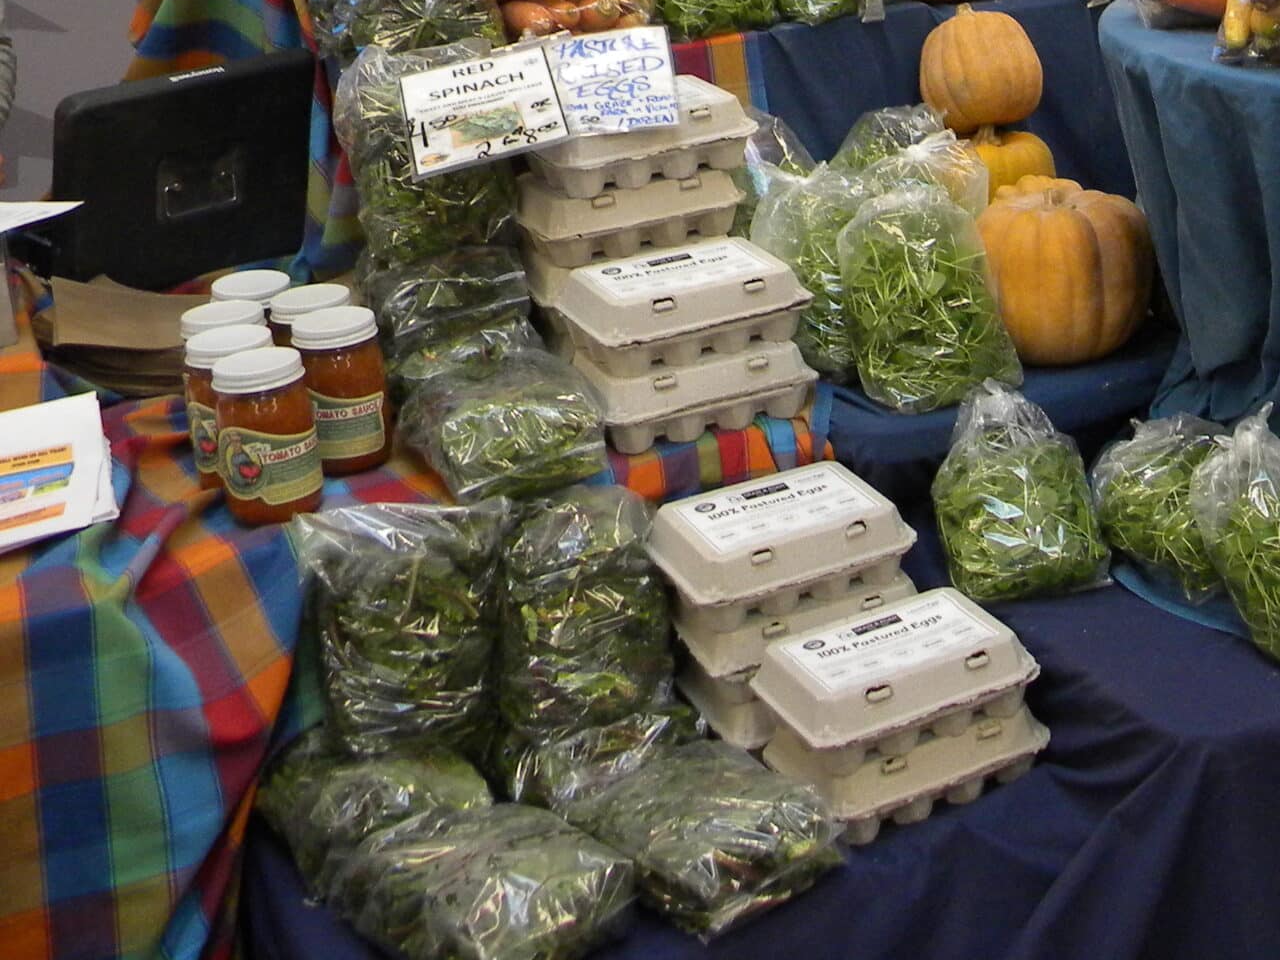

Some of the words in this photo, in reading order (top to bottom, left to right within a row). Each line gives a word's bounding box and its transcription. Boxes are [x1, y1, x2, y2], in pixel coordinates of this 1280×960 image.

[452, 61, 494, 79] RED
[556, 55, 665, 85] RISED
[428, 71, 525, 101] SPINACH
[568, 75, 652, 101] EGGS
[316, 409, 349, 420] OMATO
[261, 446, 301, 463] TOMATO
[817, 644, 851, 659] 100%
[851, 625, 909, 649] Pastured
[910, 613, 943, 630] Eggs
